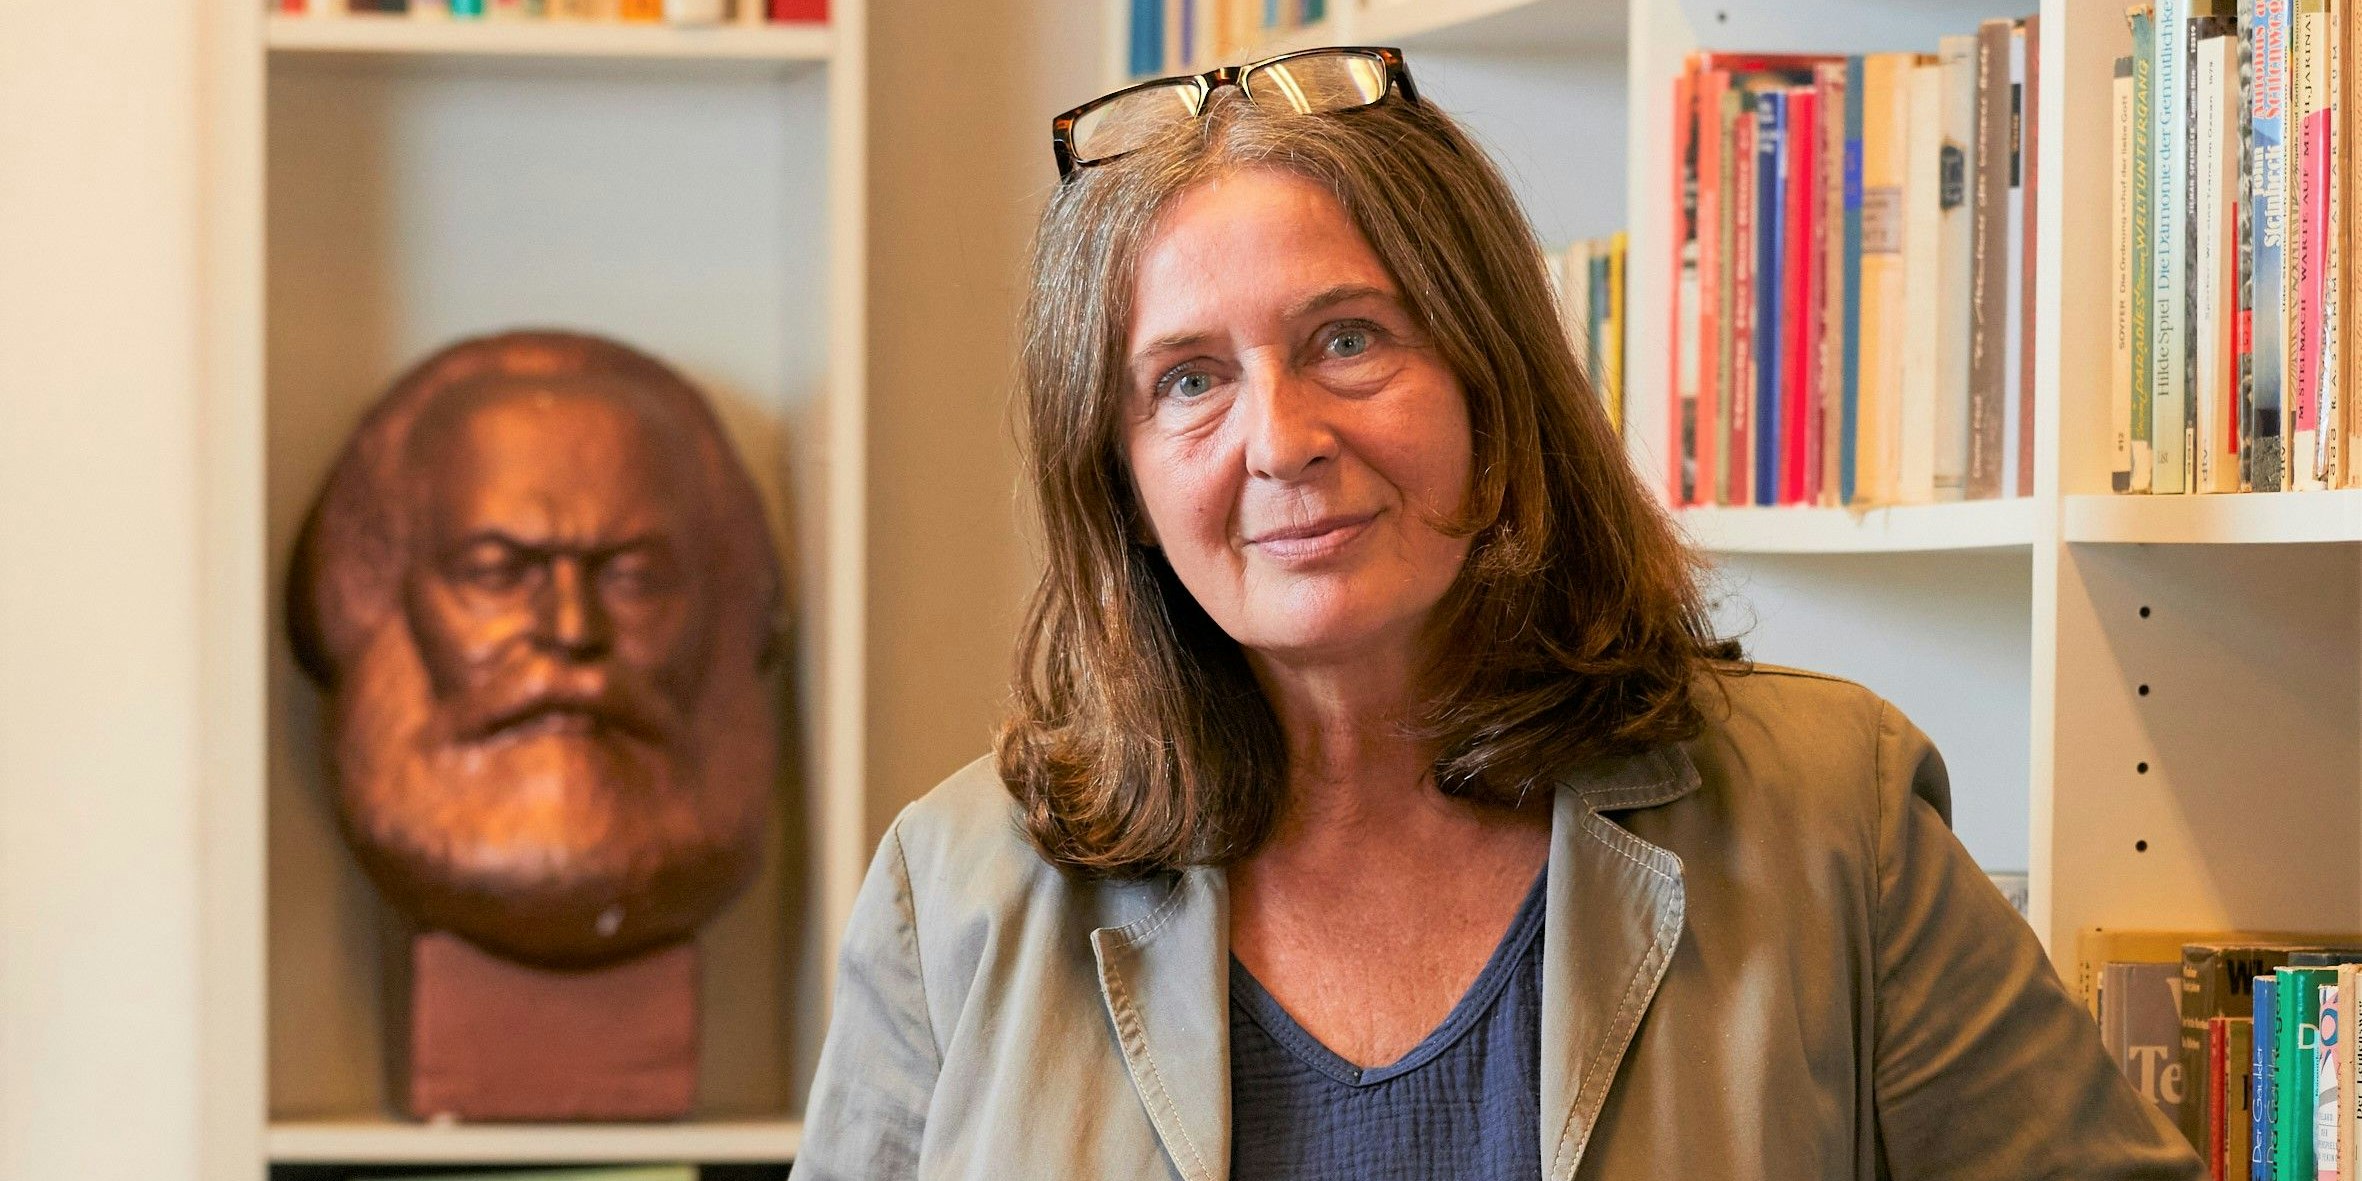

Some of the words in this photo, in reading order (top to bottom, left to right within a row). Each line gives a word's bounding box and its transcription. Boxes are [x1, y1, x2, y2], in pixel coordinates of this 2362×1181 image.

[2253, 26, 2265, 118] Autobus
[2121, 94, 2129, 124] Gott
[2136, 58, 2148, 249] WELTUNTERGANG
[2159, 128, 2171, 161] der
[2120, 180, 2128, 214] schuf
[2252, 146, 2265, 197] John
[2263, 144, 2282, 249] Steinbeck
[2120, 216, 2128, 271] Ordnung
[2158, 258, 2170, 291] Die
[2119, 299, 2127, 350] SOYFER
[2157, 298, 2174, 345] Spiel
[2157, 346, 2169, 397] Hilde
[2252, 1045, 2263, 1124] Gaukler
[2252, 1129, 2262, 1165] Der
